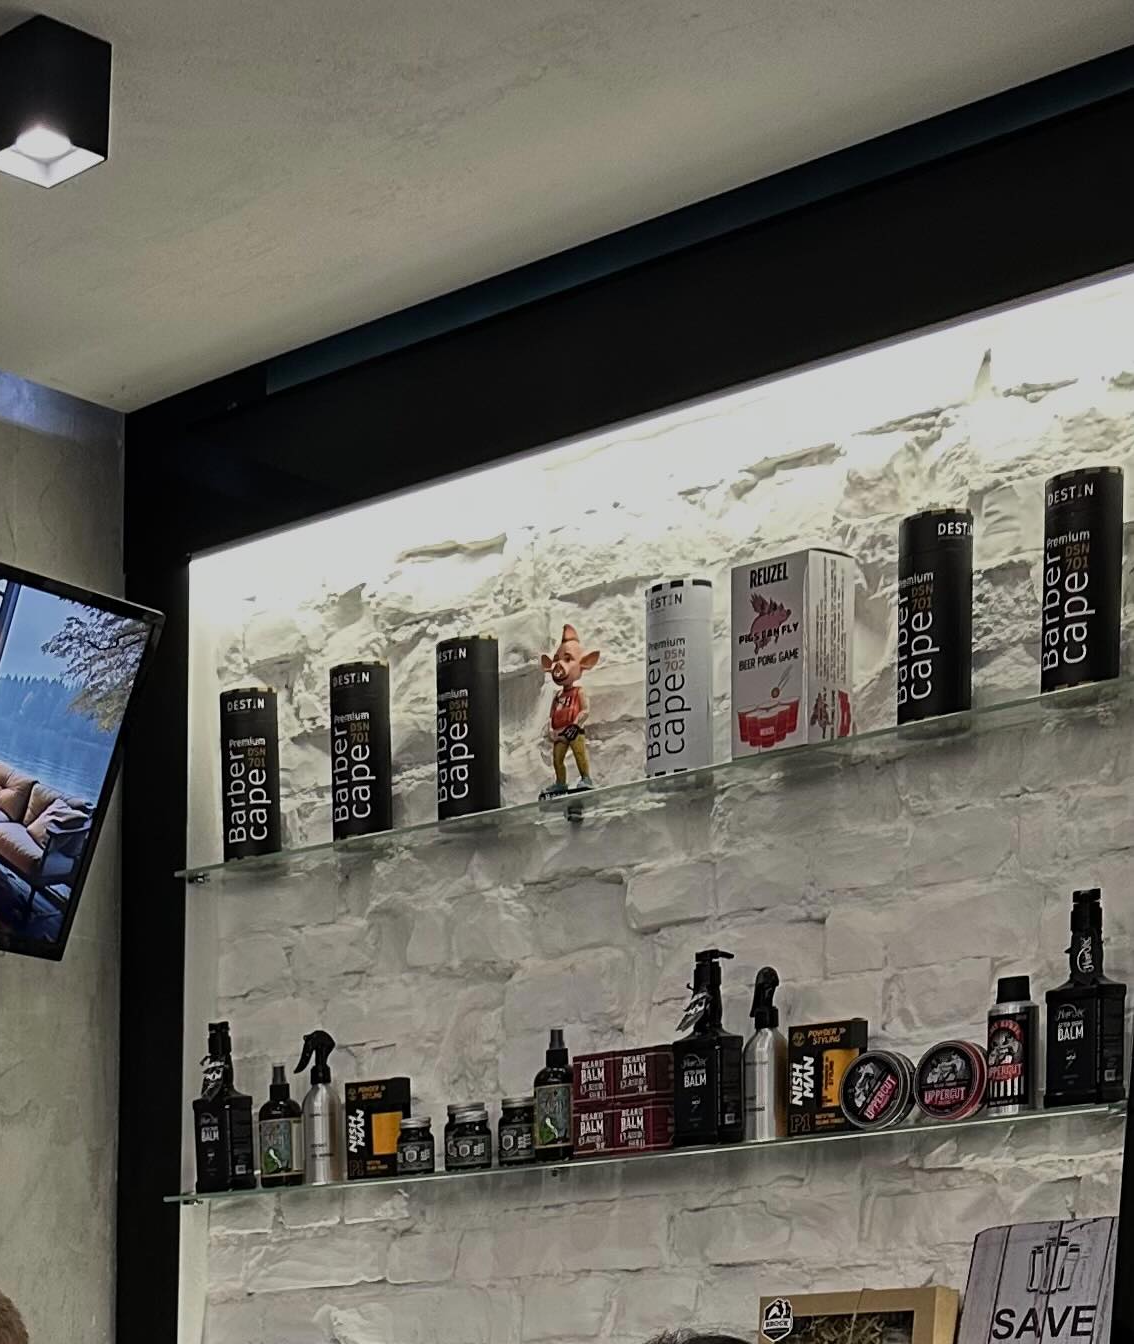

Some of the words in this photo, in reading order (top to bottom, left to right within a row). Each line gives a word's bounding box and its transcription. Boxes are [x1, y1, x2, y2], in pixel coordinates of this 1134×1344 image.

[1047, 530, 1090, 548] Premium
[1066, 543, 1090, 557] DSN
[750, 561, 788, 589] REUZEL
[1066, 557, 1089, 571] 701
[1043, 552, 1060, 671] Barber
[1063, 571, 1096, 664] cape
[782, 622, 799, 634] FLY
[665, 660, 685, 672] 702
[738, 655, 756, 671] BEER
[757, 652, 777, 667] PONG
[778, 648, 799, 662] GAME
[911, 611, 940, 700] cape
[647, 656, 661, 760] Barber
[665, 673, 691, 754] cape
[229, 737, 265, 748] Premium
[450, 723, 474, 799] cape
[333, 727, 349, 822] Barber
[351, 744, 376, 818] cape
[227, 750, 246, 844] Barber
[248, 768, 271, 840] cape
[1058, 1026, 1083, 1042] BALM
[581, 1067, 604, 1084] BALM
[622, 1062, 646, 1080] BALM
[684, 1073, 706, 1088] BALM
[803, 1056, 814, 1098] MAN
[792, 1063, 802, 1106] NISH
[925, 1087, 966, 1104] UPPERCUT
[580, 1120, 603, 1136] BALM
[621, 1116, 643, 1132] BALM
[993, 1305, 1096, 1340] SAVE
